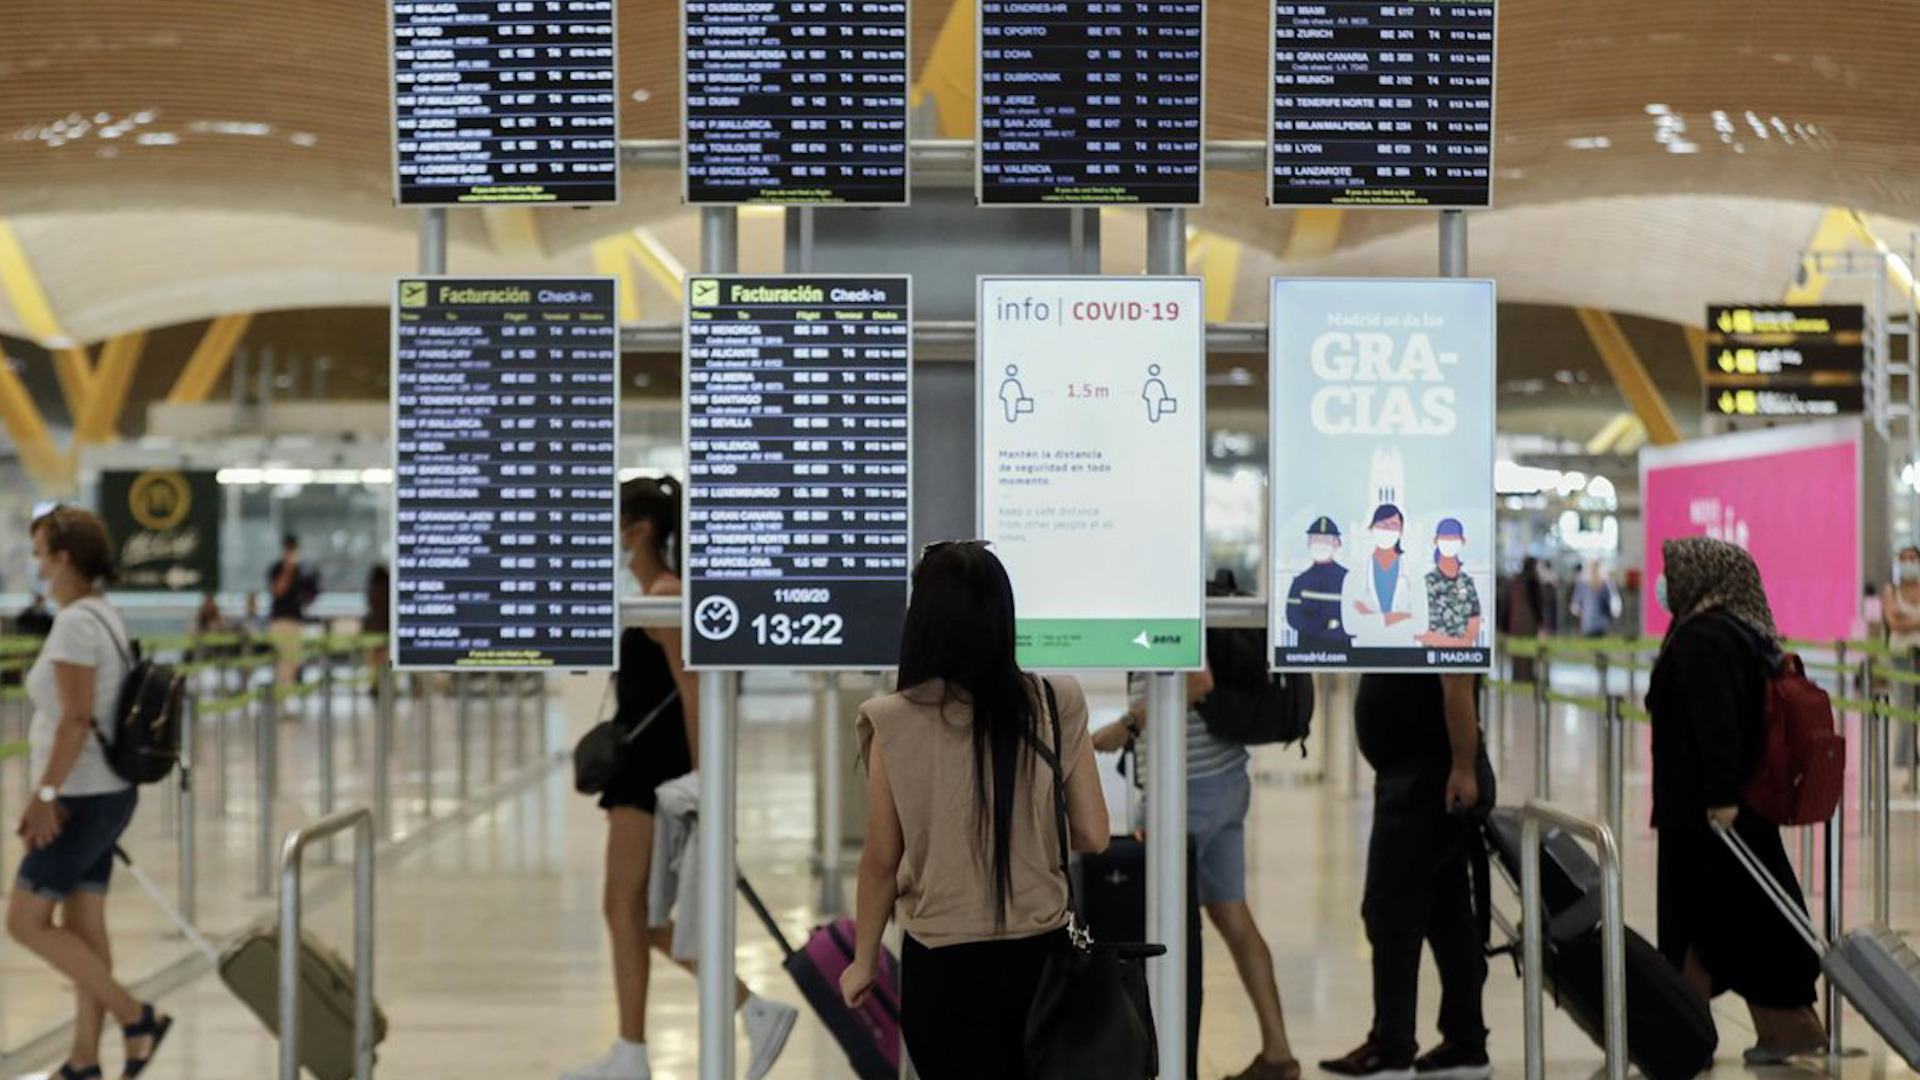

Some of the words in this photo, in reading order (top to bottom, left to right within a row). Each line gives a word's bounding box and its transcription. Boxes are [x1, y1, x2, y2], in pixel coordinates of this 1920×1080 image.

[708, 4, 773, 12] DUSSELDORF
[1298, 7, 1325, 15] MIAMI
[708, 27, 766, 36] FRANKFURT
[1005, 27, 1046, 36] OPORTO
[1297, 30, 1333, 39] ZURICH
[1005, 51, 1032, 59] DOHA
[1297, 53, 1325, 61] GRAN
[1326, 53, 1368, 61] CANARIA
[1005, 74, 1061, 82] DUBROVNIK
[1297, 76, 1334, 84] MUNICH
[1004, 97, 1035, 105] JEREZ
[1297, 99, 1341, 107] TENERIFE
[1343, 99, 1374, 107] NORTE
[1005, 120, 1025, 128] SAN
[1026, 120, 1051, 128] JOSE
[710, 144, 761, 152] TOULOUSE
[1004, 143, 1039, 151] BERLIN
[1295, 144, 1322, 153] LYON
[710, 167, 768, 176] BARCELONA
[1004, 165, 1051, 174] VALENCIA
[1295, 167, 1351, 176] LANZAROTE
[440, 287, 530, 303] Facturación
[538, 290, 592, 302] Check-in
[731, 286, 823, 302] Facturación
[831, 289, 885, 302] Check-in
[997, 297, 1049, 321] info
[1327, 312, 1381, 327] Madrid
[712, 326, 761, 334] MENORCA
[711, 349, 759, 358] ALICANTE
[1310, 332, 1458, 382] GRA-
[1067, 383, 1092, 398] 1.5
[1095, 387, 1109, 398] m
[711, 395, 761, 404] SANTIAGO
[1310, 386, 1456, 436] CIAS
[711, 419, 752, 427] SEVILLA
[711, 442, 760, 450] VALENCIA
[999, 450, 1038, 459] Mantén
[1042, 450, 1051, 458] la
[1054, 450, 1102, 458] distancia
[712, 465, 736, 473] VIGO
[999, 463, 1011, 472] de
[1015, 463, 1067, 473] seguridad
[1071, 464, 1083, 472] en
[1088, 464, 1111, 472] todo
[711, 488, 779, 497] LUXEMBURGO
[711, 558, 771, 567] BARCELONA
[774, 589, 830, 603] 11/09/20
[752, 614, 842, 645] 13:22
[1152, 634, 1181, 644] aena
[1286, 652, 1347, 663] esmadrid.com
[1440, 653, 1483, 663] MADRID
